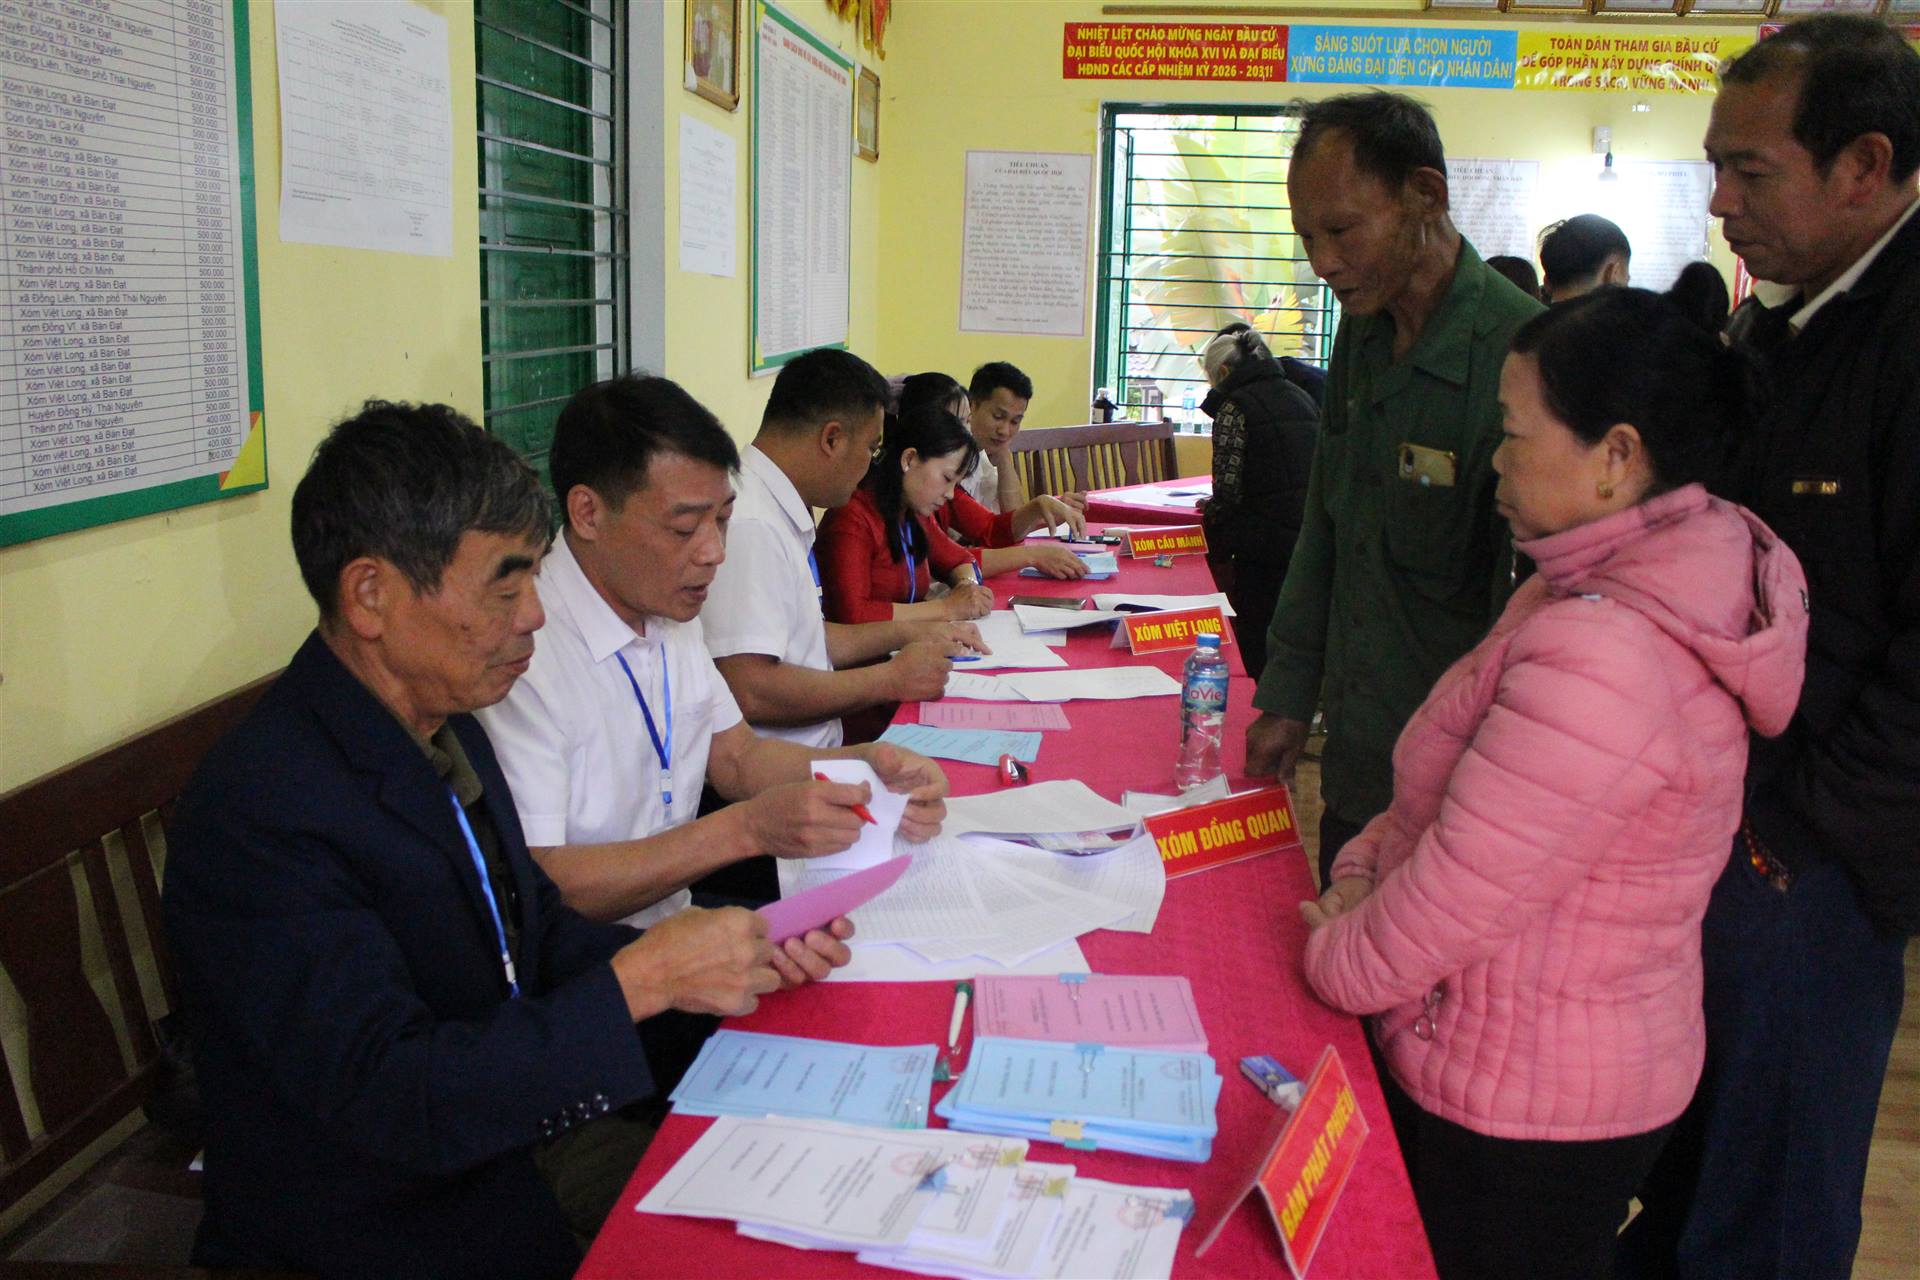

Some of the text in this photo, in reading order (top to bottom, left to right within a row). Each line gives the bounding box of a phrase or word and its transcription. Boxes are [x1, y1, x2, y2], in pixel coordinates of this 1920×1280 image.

[1077, 25, 1277, 43] NHIỆT LIỆT CHÀO MỪNG NGÀY BẦU CỬ
[1315, 31, 1348, 52] SÁNG
[1351, 33, 1384, 53] SUỐT
[1414, 37, 1448, 58] CHỌN
[1451, 35, 1492, 56] NGƯỜI
[1551, 34, 1582, 50] TOÀN
[1585, 35, 1611, 51] DÂN
[1615, 39, 1649, 52] THAM
[1652, 40, 1672, 53] GIA
[1675, 36, 1699, 53] BẦU
[1067, 41, 1285, 62] ĐẠI BIỂU QUỐC HỘI KHÓA XVI VÀ ĐẠI BIỂU
[1539, 52, 1563, 68] GÓP
[1566, 52, 1599, 69] PHẦN
[1602, 54, 1625, 70] XÂY
[1078, 63, 1110, 75] HĐND
[1112, 60, 1133, 75] CÁC
[1135, 60, 1156, 75] CẤP
[1158, 60, 1193, 79] NHIỆM
[1196, 61, 1210, 76] KỲ
[1212, 65, 1237, 77] 2026
[1246, 65, 1273, 78] 2031!
[1291, 52, 1325, 73] XỨNG
[1328, 53, 1361, 74] ĐÁNG
[1364, 57, 1385, 79] ĐẠI
[1418, 59, 1444, 77] CHO
[1447, 57, 1481, 78] NHÂN
[1484, 57, 1513, 79] DÂN!
[1134, 538, 1156, 551] XÓM
[1134, 618, 1222, 641] XÓM VIỆT LONG
[1156, 807, 1291, 861] XÓM ĐỒNG QUAN
[1281, 1180, 1309, 1241] BÀN
[1302, 1133, 1331, 1198] PHÁT
